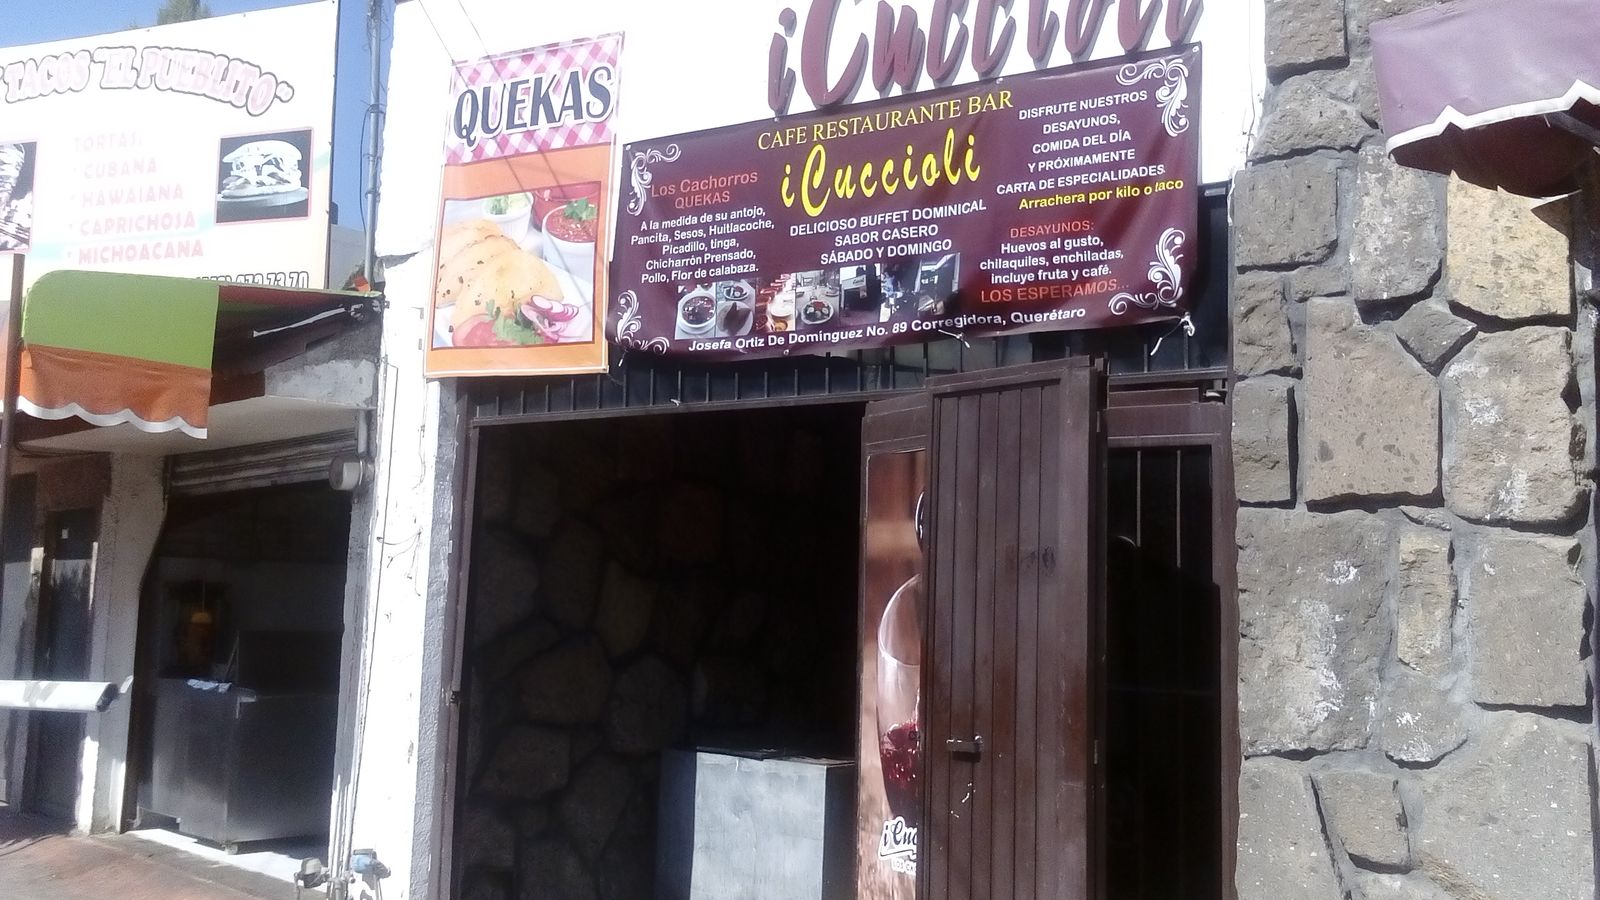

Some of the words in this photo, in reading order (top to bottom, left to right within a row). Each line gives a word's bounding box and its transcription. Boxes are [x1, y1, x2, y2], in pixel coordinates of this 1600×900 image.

[4, 49, 92, 103] TACOS
[454, 66, 612, 147] QUEKAS
[1019, 102, 1077, 120] DISFRUTE
[1080, 91, 1148, 110] NUESTROS
[758, 127, 807, 150] CAFE
[813, 100, 961, 142] RESTAURANTE
[968, 91, 1013, 116] BAR
[1043, 114, 1121, 134] DESAYUNOS,
[1032, 139, 1079, 154] COMIDA
[1083, 134, 1106, 147] DEL
[1109, 130, 1131, 143] DÍA
[83, 157, 157, 180] CUBANA
[781, 128, 980, 217] iCuccioli
[1028, 162, 1037, 173] Y
[1039, 149, 1135, 171] PRÓXIMAMENTE
[81, 183, 184, 209] HAWAIANA
[651, 184, 676, 198] Los
[680, 172, 758, 193] Cachorros
[996, 181, 1036, 195] CARTA
[1039, 178, 1055, 190] DE
[675, 190, 730, 209] QUEKAS
[1019, 195, 1085, 210] Arrachera
[1089, 190, 1112, 204] por
[1116, 185, 1139, 199] kilo
[1144, 186, 1152, 196] o
[79, 211, 197, 237] CAPRICHOSA
[640, 220, 648, 231] A
[650, 220, 659, 230] la
[662, 215, 698, 229] medida
[700, 213, 713, 223] de
[715, 212, 728, 221] su
[730, 206, 766, 219] antojo,
[790, 217, 857, 236] DELICIOSO
[860, 210, 909, 227] BUFFET
[912, 199, 986, 221] DOMINICAL
[1010, 220, 1094, 239] DESAYUNOS:
[631, 233, 672, 246] Pancita,
[674, 229, 706, 241] Sesos,
[709, 219, 775, 236] Huitlacoche,
[835, 230, 879, 246] SABOR
[882, 224, 939, 241] CASERO
[77, 239, 204, 265] MICHOACANA
[662, 242, 708, 255] Picadillo,
[710, 238, 739, 250] tinga,
[820, 247, 873, 264] SÁBADO
[876, 246, 884, 258] Y
[887, 238, 952, 256] DOMINGO
[1001, 241, 1046, 254] Huevos
[1050, 239, 1061, 250] al
[1064, 236, 1104, 253] gusto,
[646, 255, 702, 270] Chicharrón
[704, 248, 756, 264] Prensado,
[979, 256, 1049, 272] chilaquiles,
[1053, 249, 1123, 264] enchiladas,
[641, 273, 669, 284] Pollo,
[671, 270, 692, 281] Flor
[694, 268, 707, 279] de
[709, 263, 759, 277] calabaza.
[991, 270, 1035, 285] incluye
[1038, 268, 1068, 281] fruta
[1071, 270, 1079, 281] y
[1082, 265, 1112, 278] café.
[981, 289, 1012, 303] LOS
[1017, 279, 1129, 301] ESPERAMOS...
[688, 339, 732, 352] Josefa
[736, 335, 765, 350] Ortiz
[768, 334, 785, 347] De
[789, 327, 863, 344] Domínguez
[866, 324, 889, 338] No.
[892, 321, 908, 334] 89
[911, 313, 1007, 333] Corregidora,
[1010, 306, 1086, 324] Querétaro
